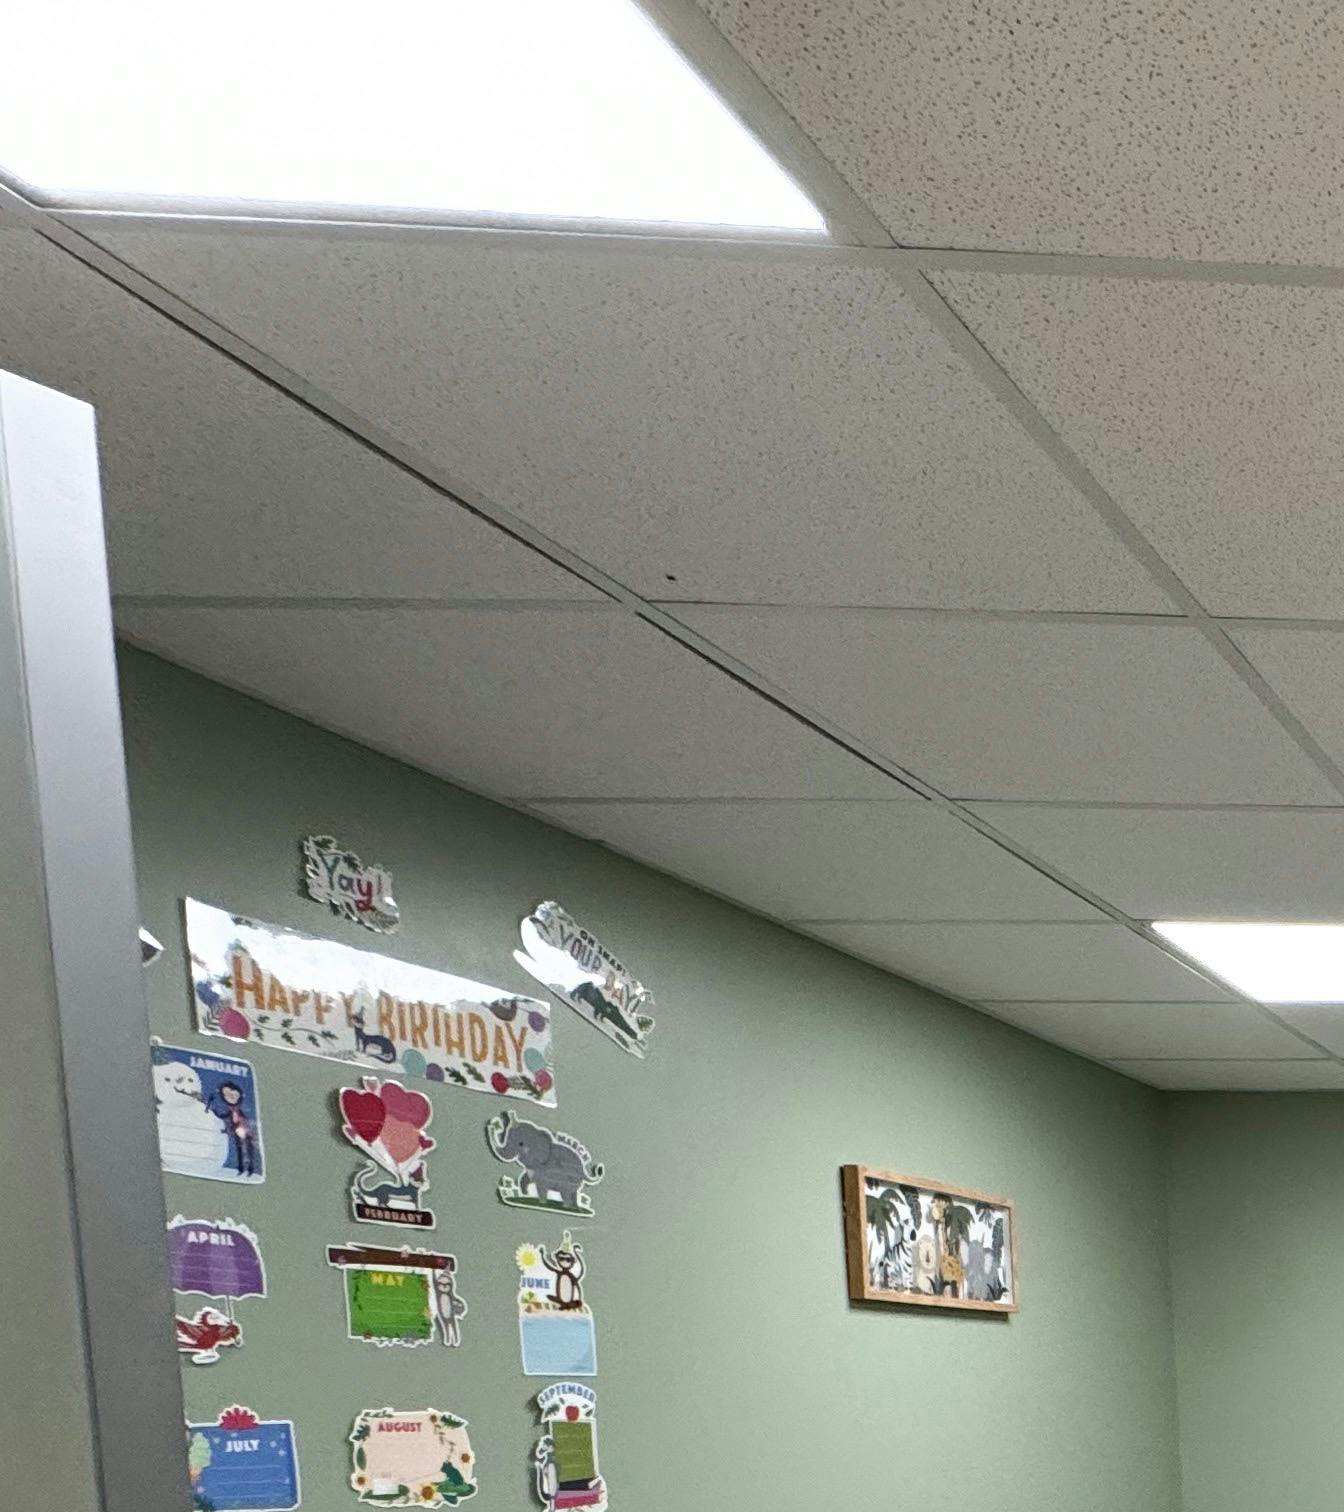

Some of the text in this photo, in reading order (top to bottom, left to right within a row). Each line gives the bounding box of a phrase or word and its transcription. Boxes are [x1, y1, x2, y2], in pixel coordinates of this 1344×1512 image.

[377, 989, 528, 1072] BIRTHDAY
[190, 1055, 248, 1078] JANUARY
[364, 1207, 423, 1224] FEBRUARY
[187, 1230, 236, 1247] APRIL
[369, 1272, 404, 1287] MAY
[521, 1277, 551, 1289] JUNE
[540, 1384, 595, 1404] SEPTEMBER
[377, 1421, 423, 1433] AUGUST
[225, 1439, 260, 1453] JULY
